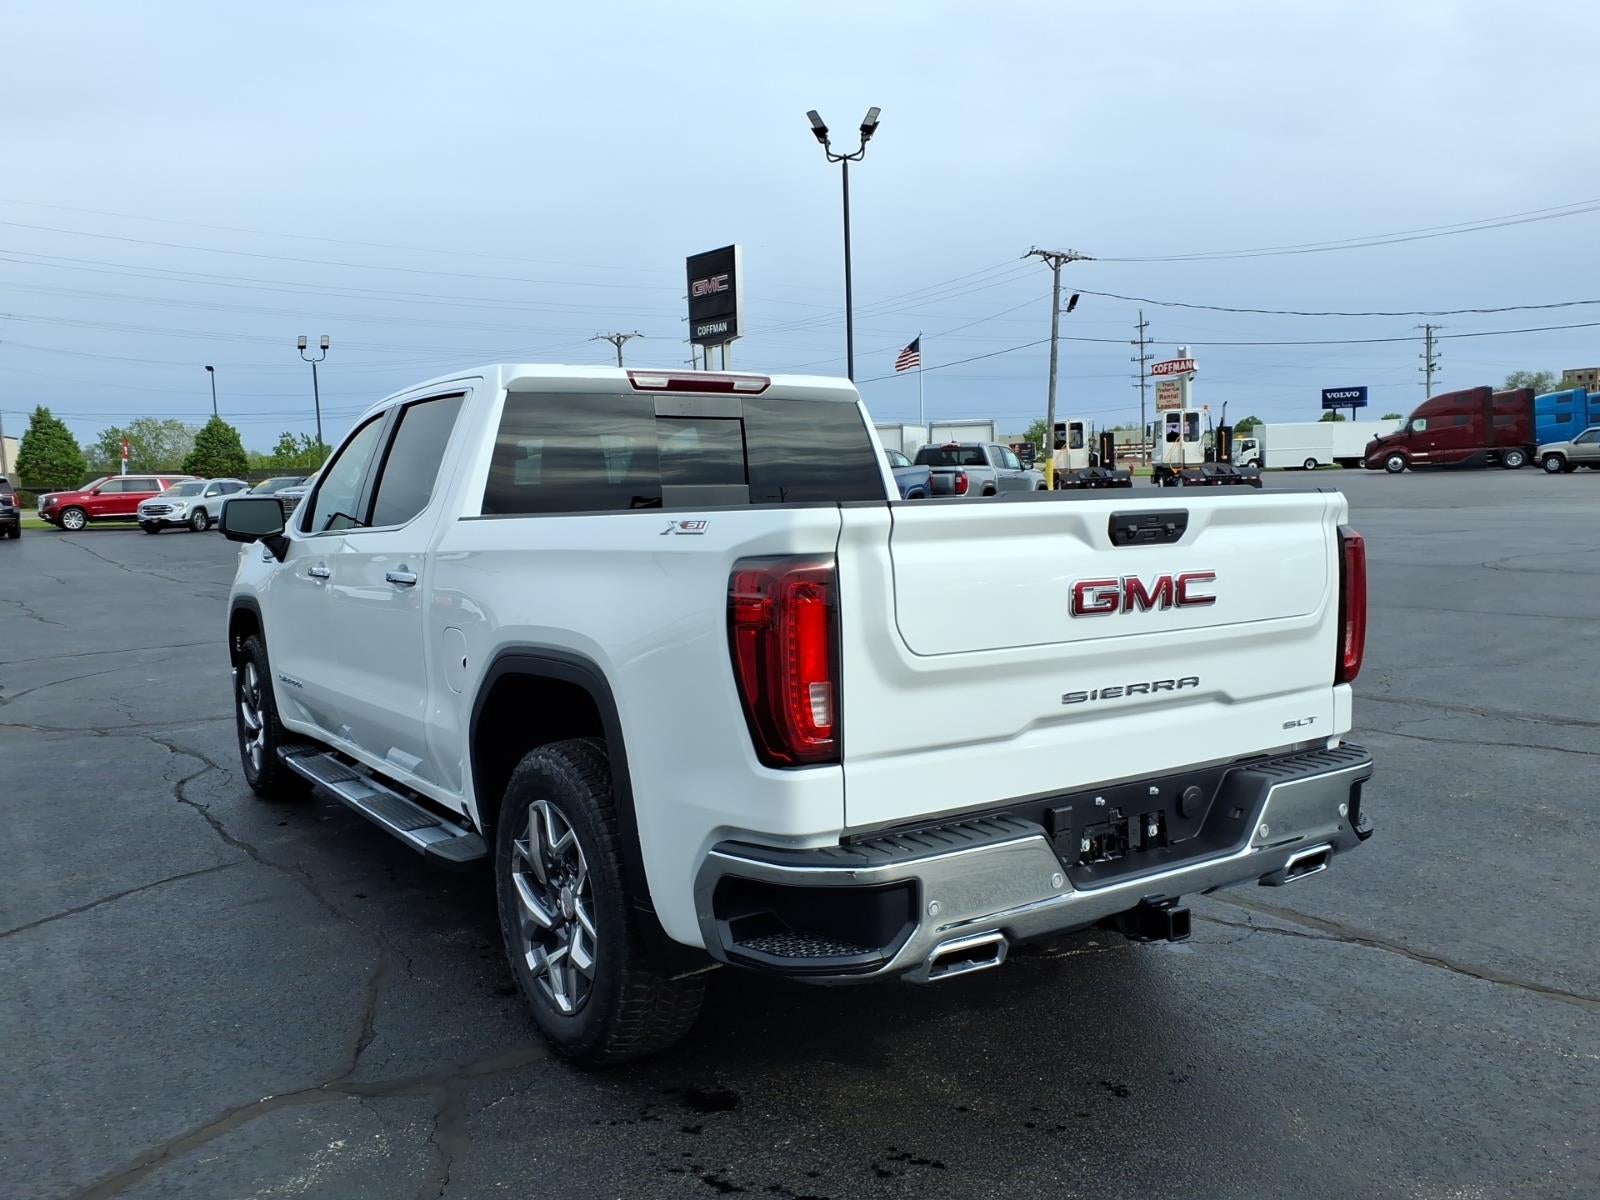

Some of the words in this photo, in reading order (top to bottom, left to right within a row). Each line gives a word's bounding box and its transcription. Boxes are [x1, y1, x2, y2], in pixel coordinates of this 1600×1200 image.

[692, 274, 728, 297] GMC
[697, 321, 728, 336] COFFMAN
[1153, 361, 1192, 373] COFFMAN
[1069, 569, 1217, 618] GMC
[1061, 676, 1200, 704] SIERRA
[1282, 716, 1318, 730] SLT
